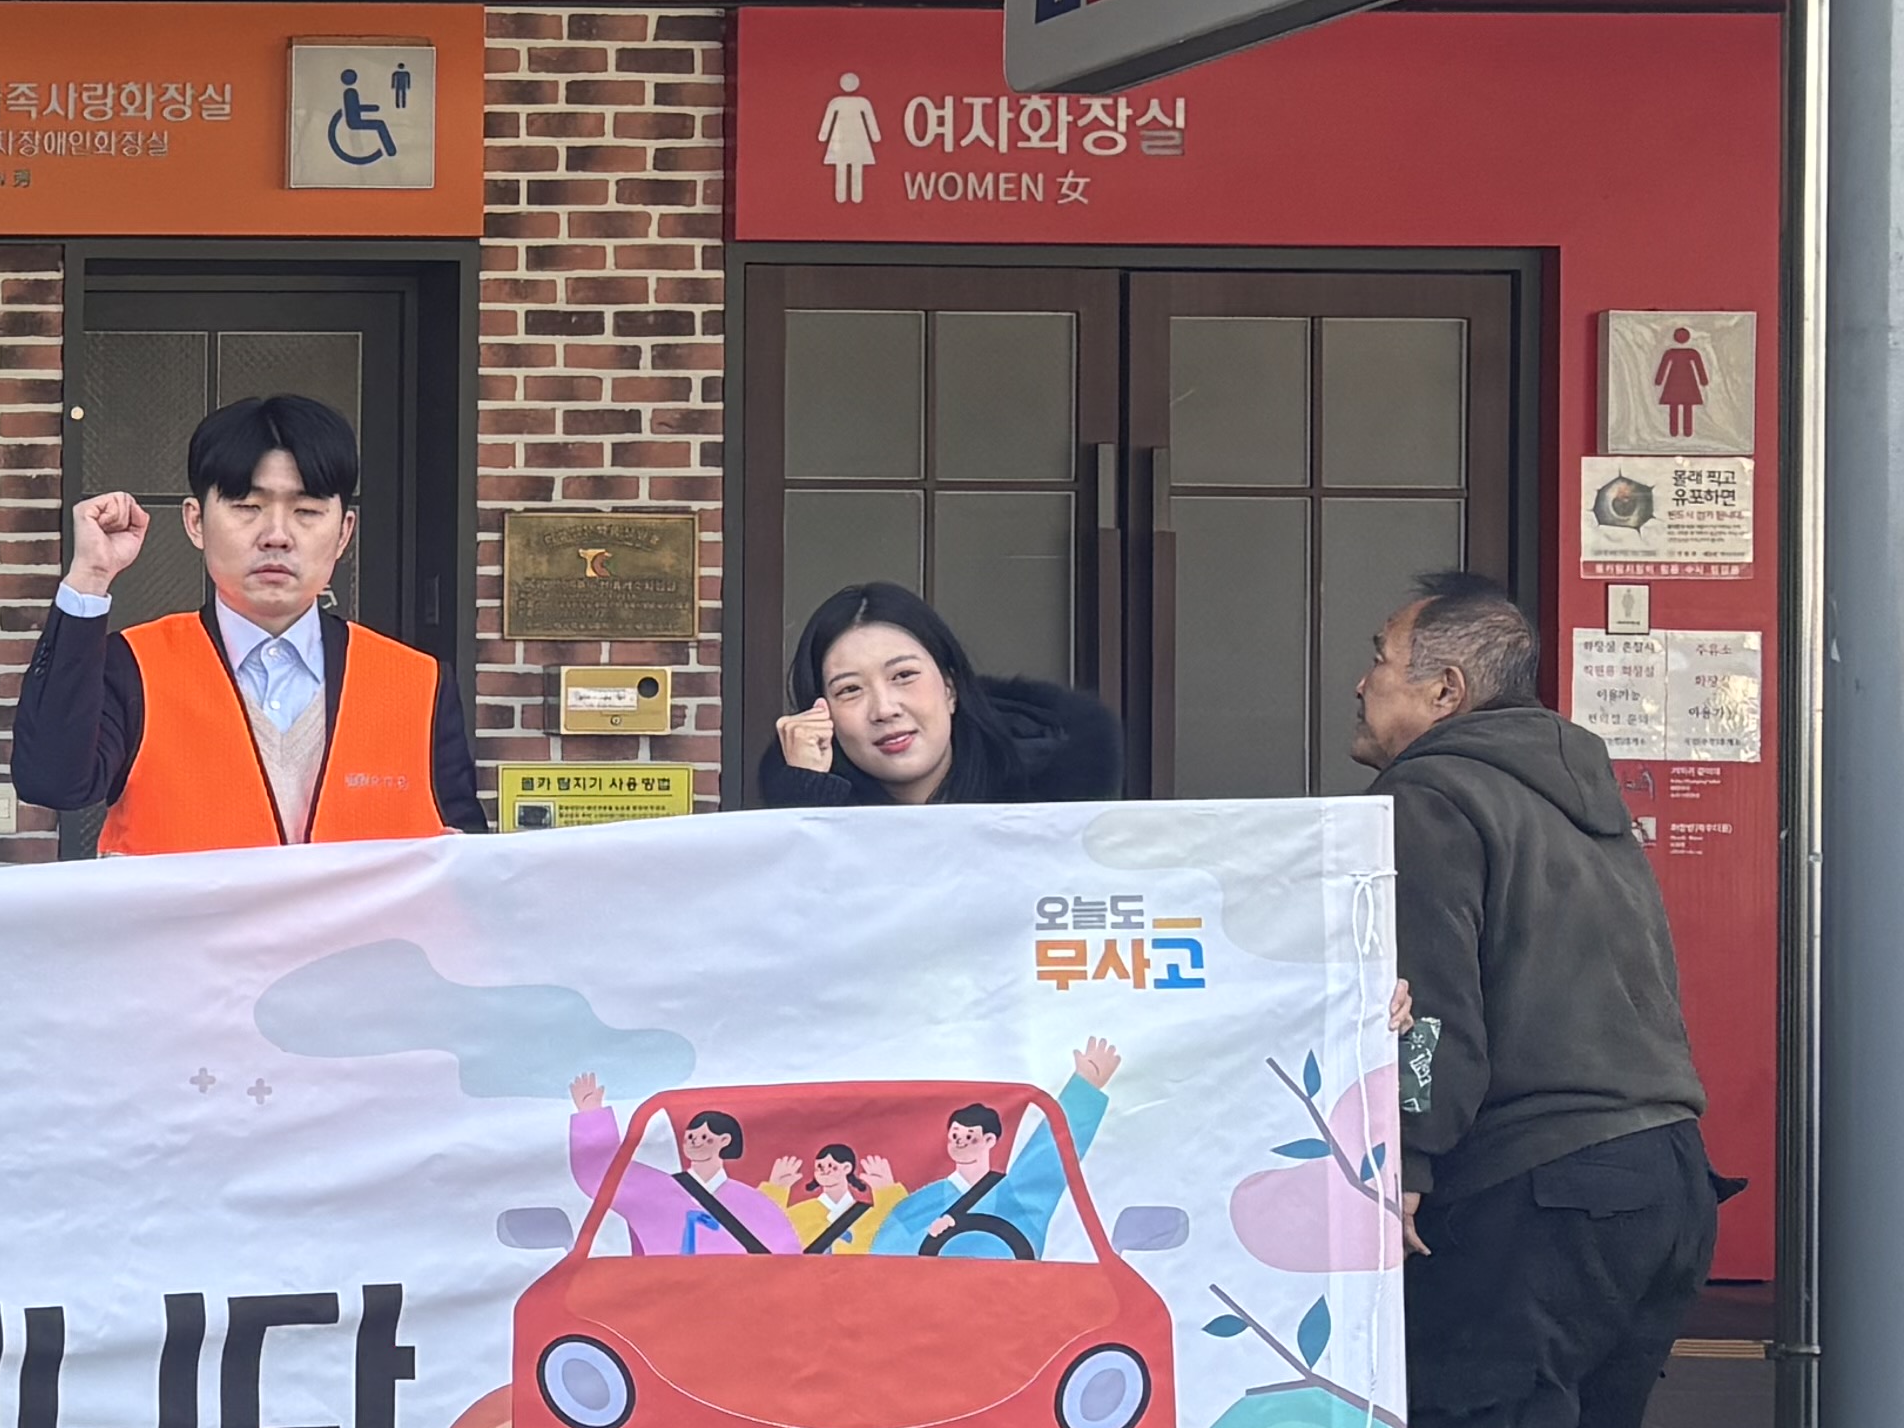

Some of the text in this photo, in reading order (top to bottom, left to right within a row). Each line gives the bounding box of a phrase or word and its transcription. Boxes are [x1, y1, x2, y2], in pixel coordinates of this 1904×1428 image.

[903, 94, 1187, 156] 여자화장실
[903, 169, 1092, 205] WOMEN 女
[1673, 469, 1737, 488] 몰래 찍고
[1671, 488, 1737, 507] 유포하면
[1696, 644, 1733, 656] 주유소
[609, 776, 671, 791] 사용방법
[1035, 895, 1145, 932] 오늘도
[1035, 936, 1206, 992] 무사고
